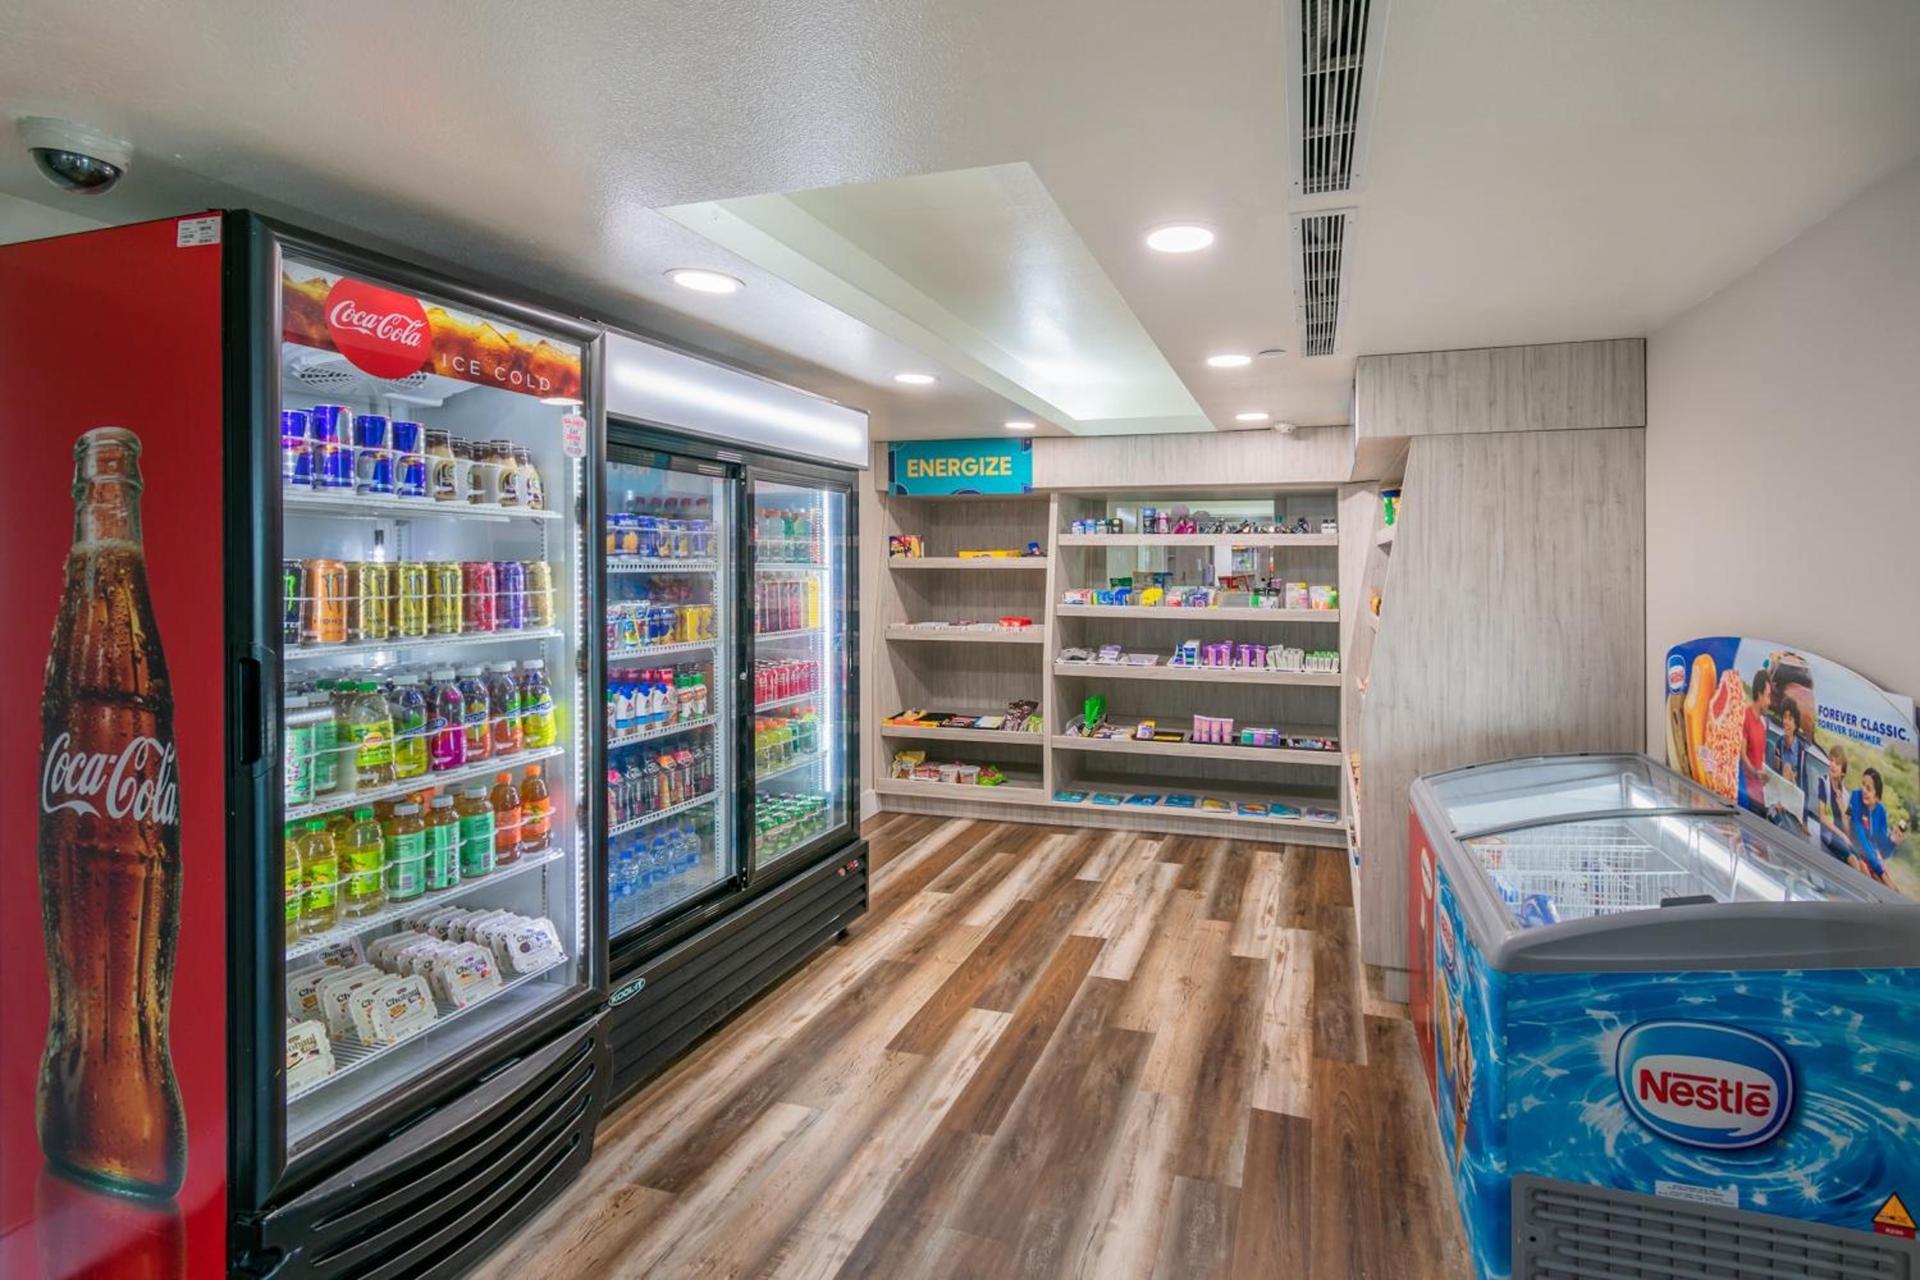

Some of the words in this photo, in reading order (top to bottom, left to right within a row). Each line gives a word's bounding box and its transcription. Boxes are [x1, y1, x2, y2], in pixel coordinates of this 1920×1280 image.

[330, 300, 425, 347] Coca-Cola
[442, 353, 480, 375] ICE
[494, 366, 551, 391] COLD
[907, 456, 1012, 477] ENERGIZE
[1817, 704, 1857, 726] FOREVER
[1860, 717, 1910, 742] CLASSIC.
[1817, 719, 1847, 736] FOREVER
[43, 732, 178, 826] Coca-Cola
